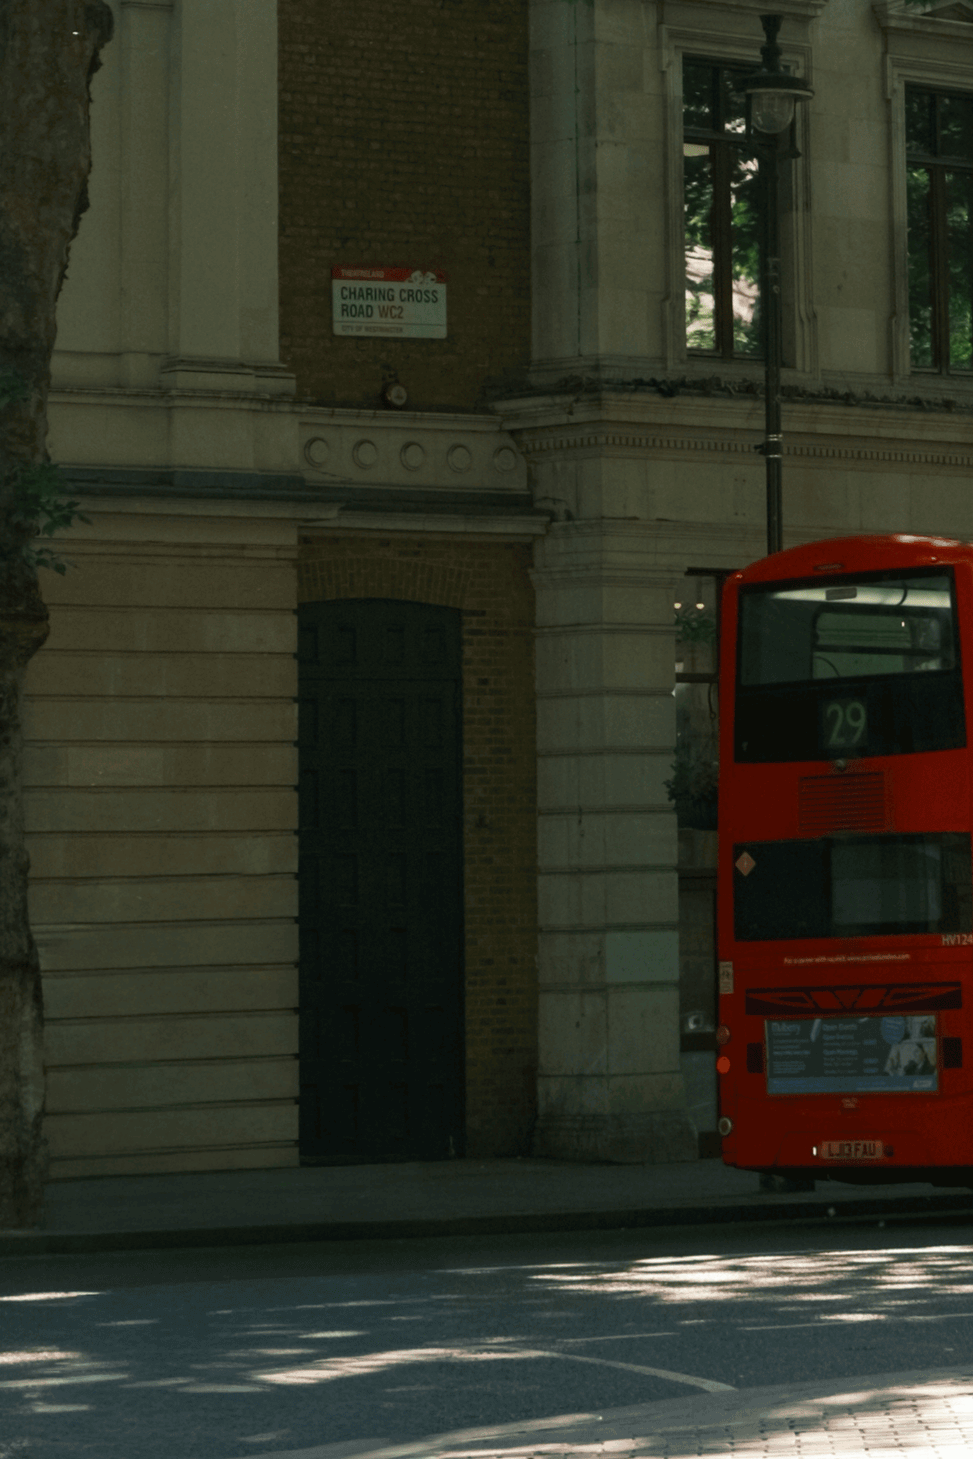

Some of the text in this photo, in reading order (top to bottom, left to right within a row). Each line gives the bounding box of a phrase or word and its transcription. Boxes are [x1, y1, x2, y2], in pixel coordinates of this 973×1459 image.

[341, 286, 439, 303] CHARING CROSS
[341, 304, 404, 319] ROAD WC2
[827, 701, 866, 744] 29
